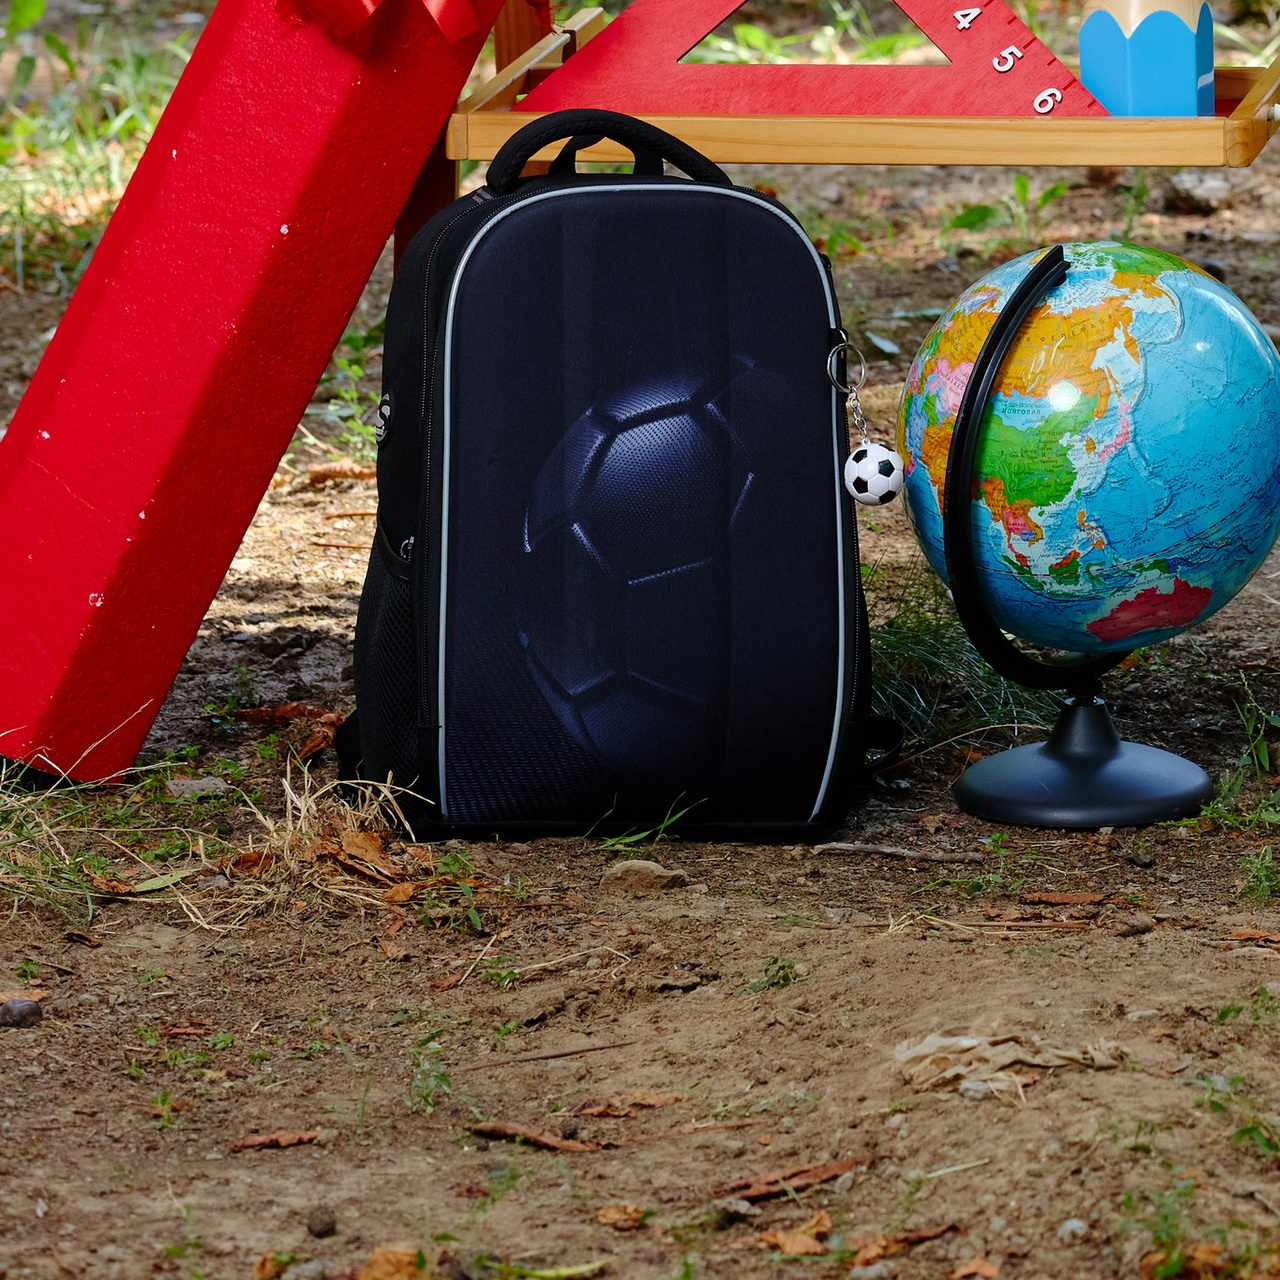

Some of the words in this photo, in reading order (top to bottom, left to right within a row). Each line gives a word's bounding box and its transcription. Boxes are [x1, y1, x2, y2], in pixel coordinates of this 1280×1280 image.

[953, 7, 982, 31] 4
[992, 45, 1023, 73] 5
[1033, 87, 1063, 114] 6
